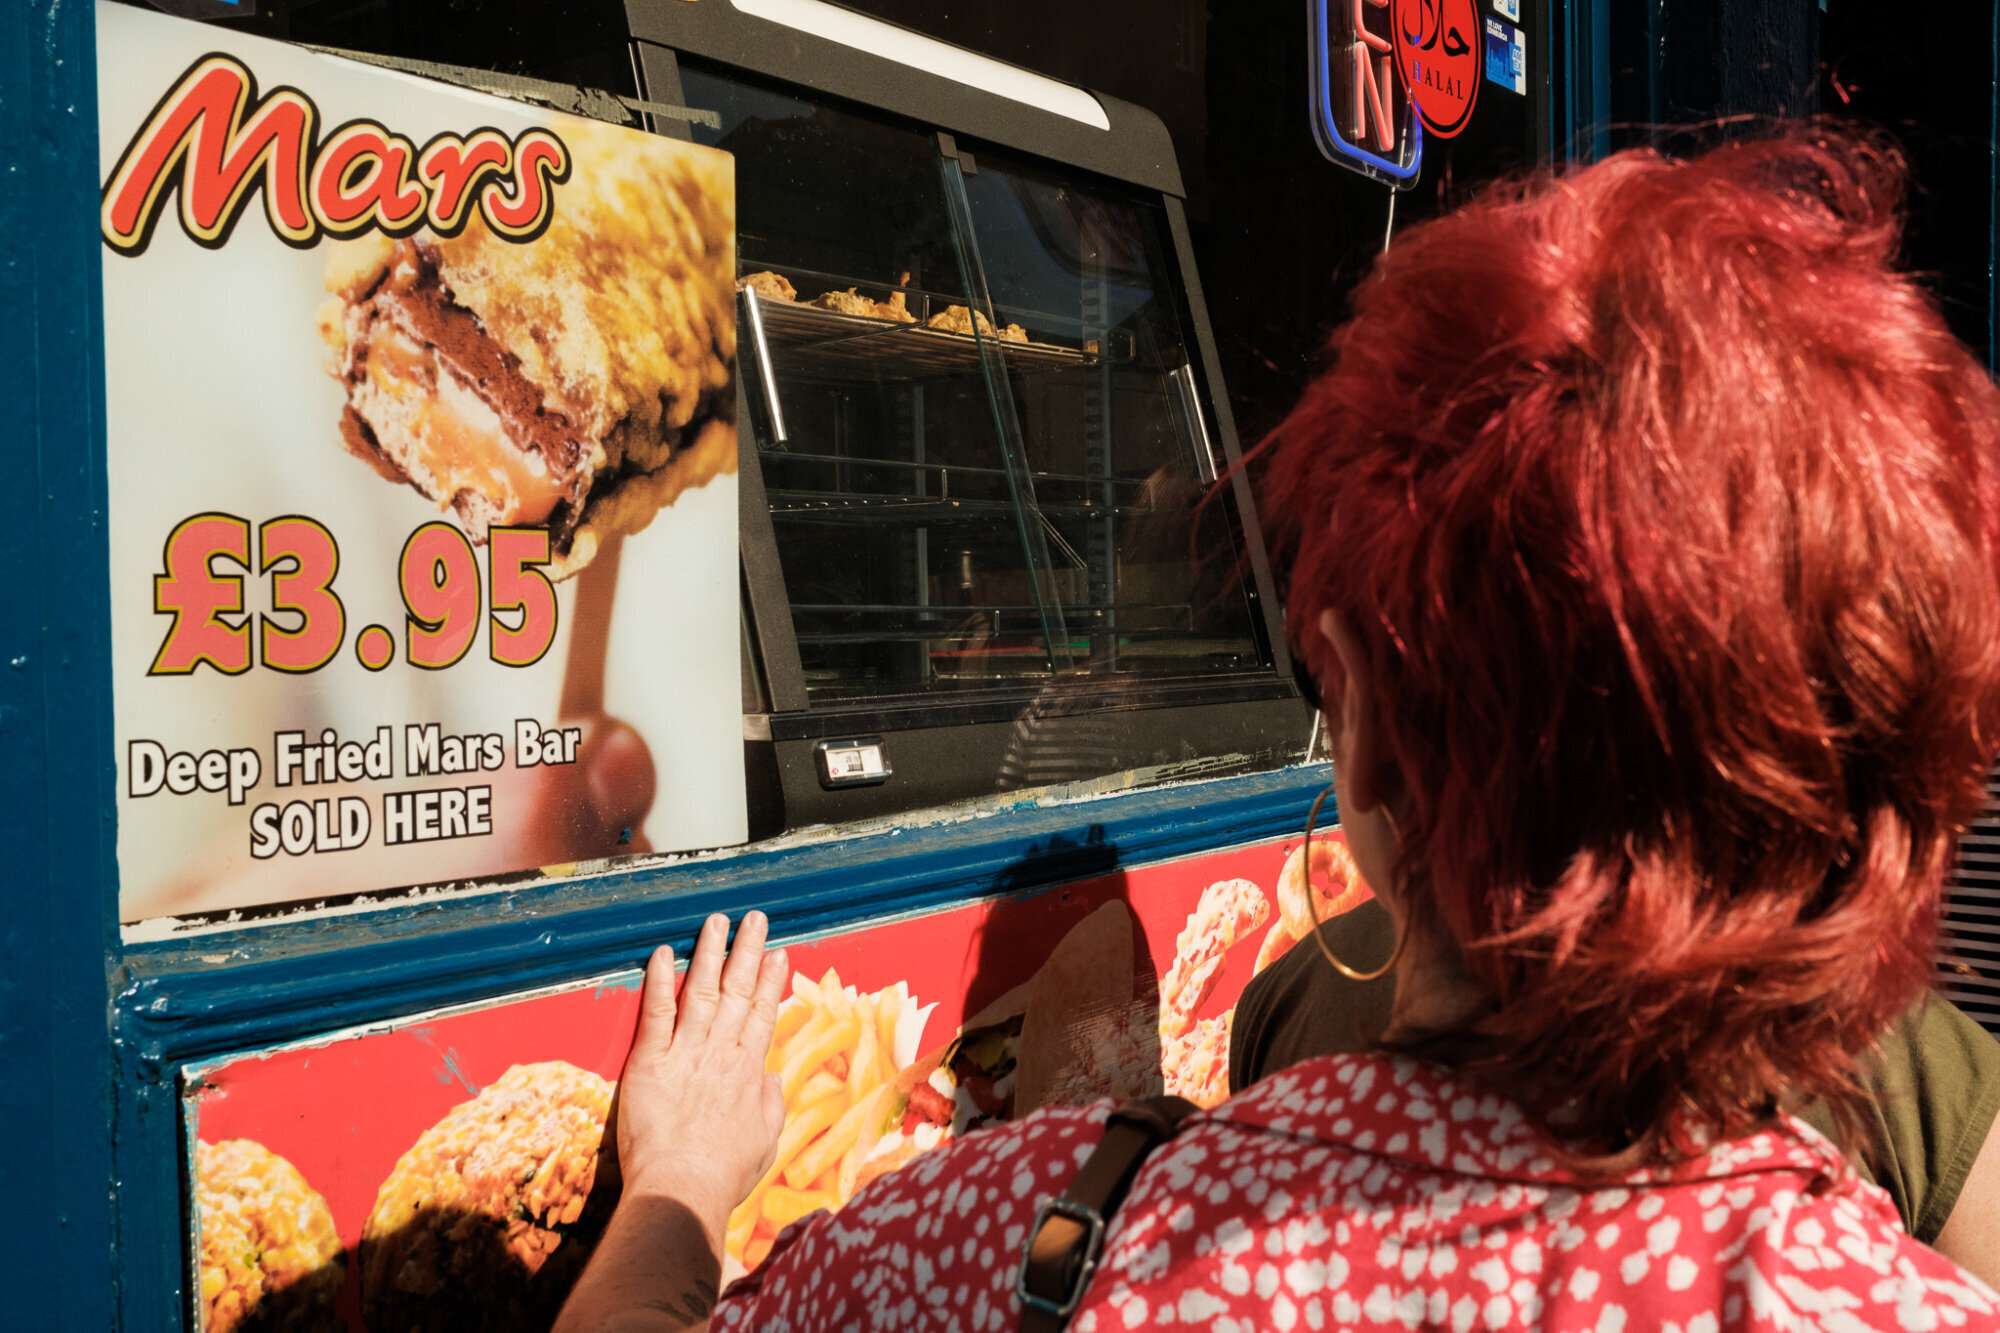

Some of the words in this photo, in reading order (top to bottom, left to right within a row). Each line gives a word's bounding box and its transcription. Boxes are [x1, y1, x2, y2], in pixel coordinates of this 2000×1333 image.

[1493, 21, 1503, 32] LOVE
[1412, 59, 1463, 100] HALAL
[101, 52, 571, 257] Mars
[147, 511, 559, 676] £3.95
[128, 739, 260, 805] Deep
[274, 726, 393, 787] Fried
[405, 723, 503, 777] Mars
[515, 718, 582, 767] Bar
[250, 796, 371, 859] SOLD
[383, 785, 493, 846] HERE
